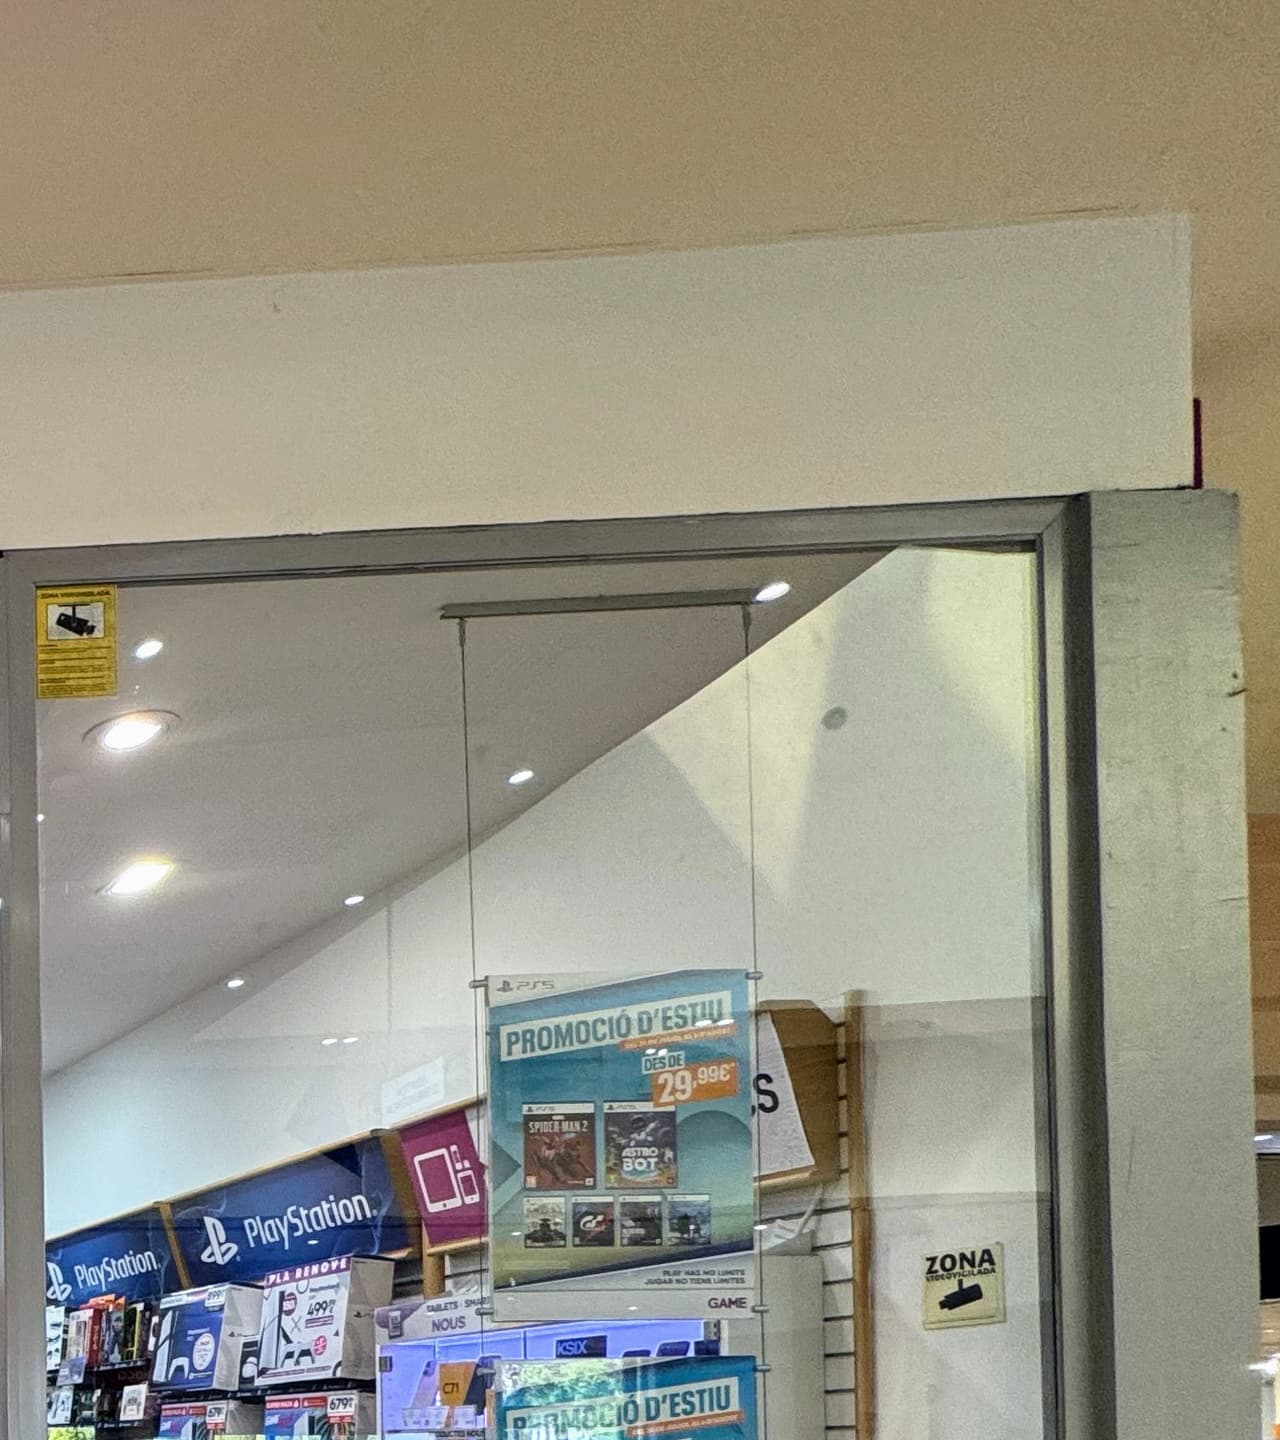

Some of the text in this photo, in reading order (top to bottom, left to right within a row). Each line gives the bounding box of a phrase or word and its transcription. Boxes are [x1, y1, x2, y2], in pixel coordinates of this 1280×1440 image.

[516, 979, 555, 991] PS5
[505, 998, 724, 1056] PROMOCIÓ D'ESTIU
[644, 1053, 683, 1071] DES DE
[581, 1120, 589, 1132] 2
[621, 1147, 658, 1157] ASTRO
[622, 1158, 659, 1172] BOT
[243, 1194, 377, 1250] PlayStation
[925, 1248, 997, 1275] ZONA
[74, 1250, 161, 1291] PlayStation
[267, 1258, 347, 1285] PLA RENOVE
[925, 1267, 997, 1282] VIDEOVIGILADA
[426, 1300, 459, 1313] TABLETS
[707, 1297, 748, 1310] GAME
[431, 1316, 466, 1333] NOUS
[556, 1339, 588, 1355] KSIX
[442, 1382, 460, 1394] C71
[645, 1384, 731, 1421] D'ESTIU
